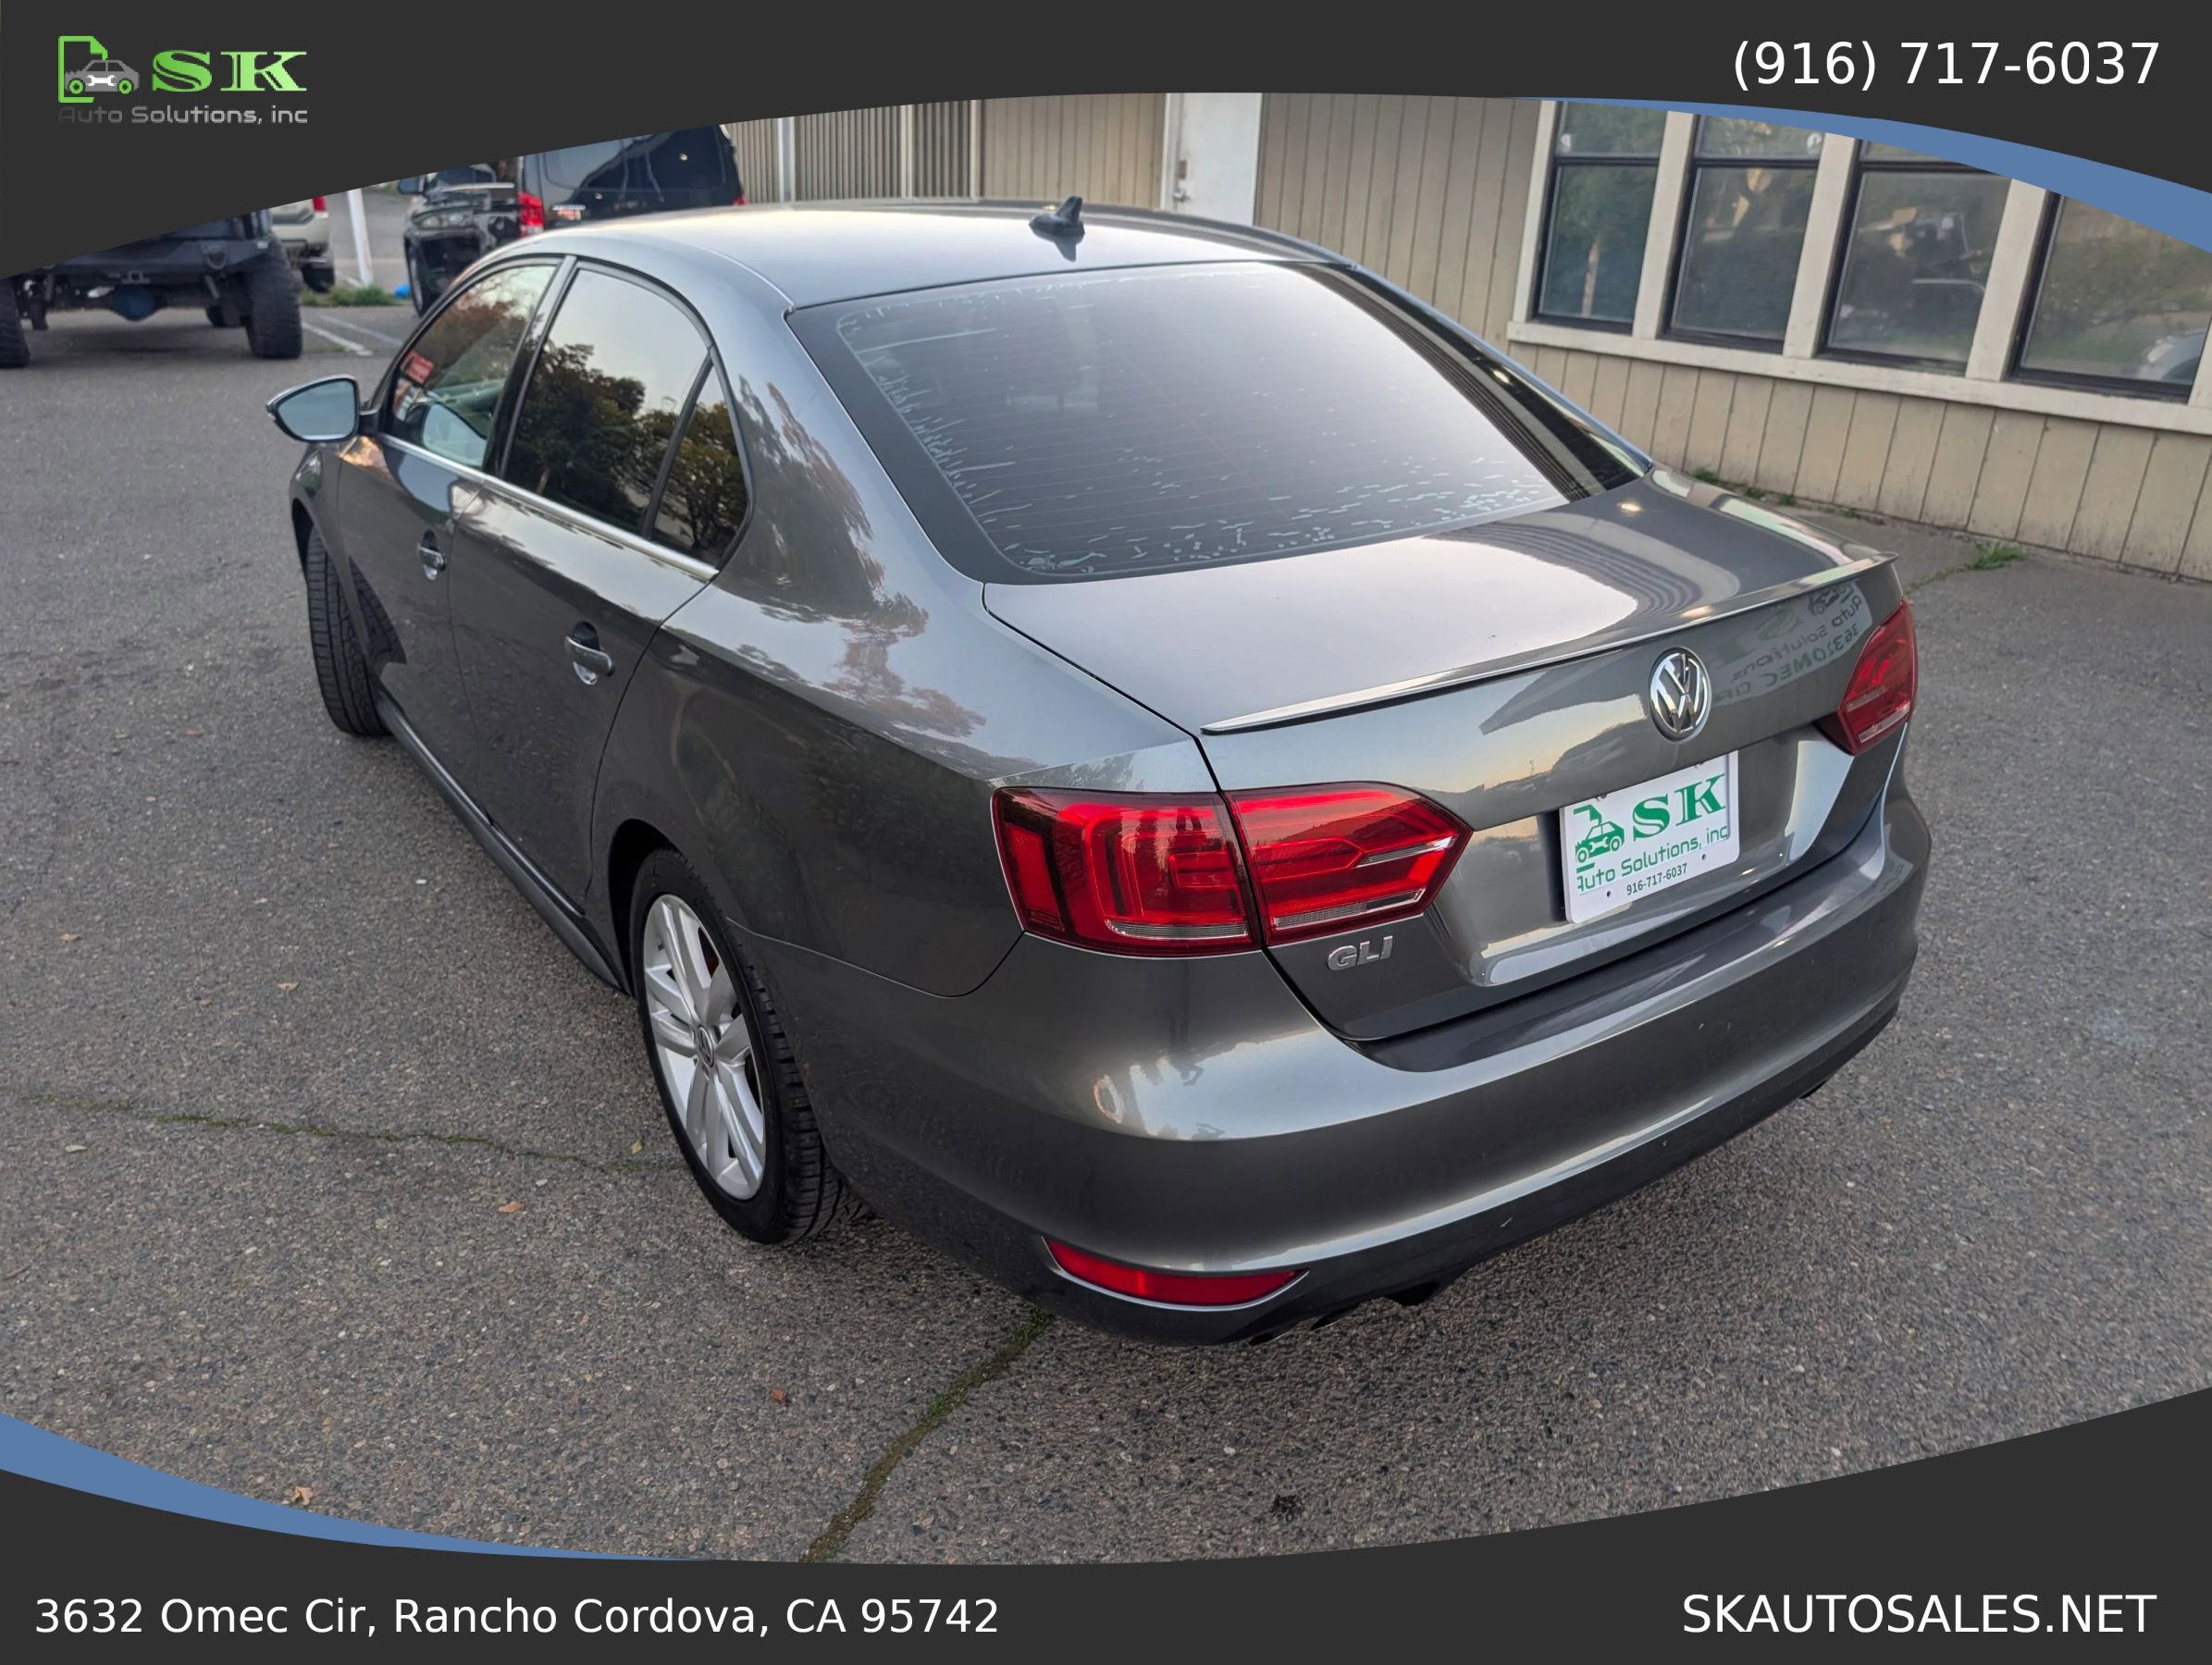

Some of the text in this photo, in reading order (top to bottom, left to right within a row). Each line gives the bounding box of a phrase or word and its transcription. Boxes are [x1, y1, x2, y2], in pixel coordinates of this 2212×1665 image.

[1632, 773, 1726, 842] SK
[1621, 836, 1702, 877] Solutions,
[1706, 825, 1728, 845] inc
[1626, 863, 1688, 895] 916-717-6037
[1327, 934, 1393, 971] GLI
